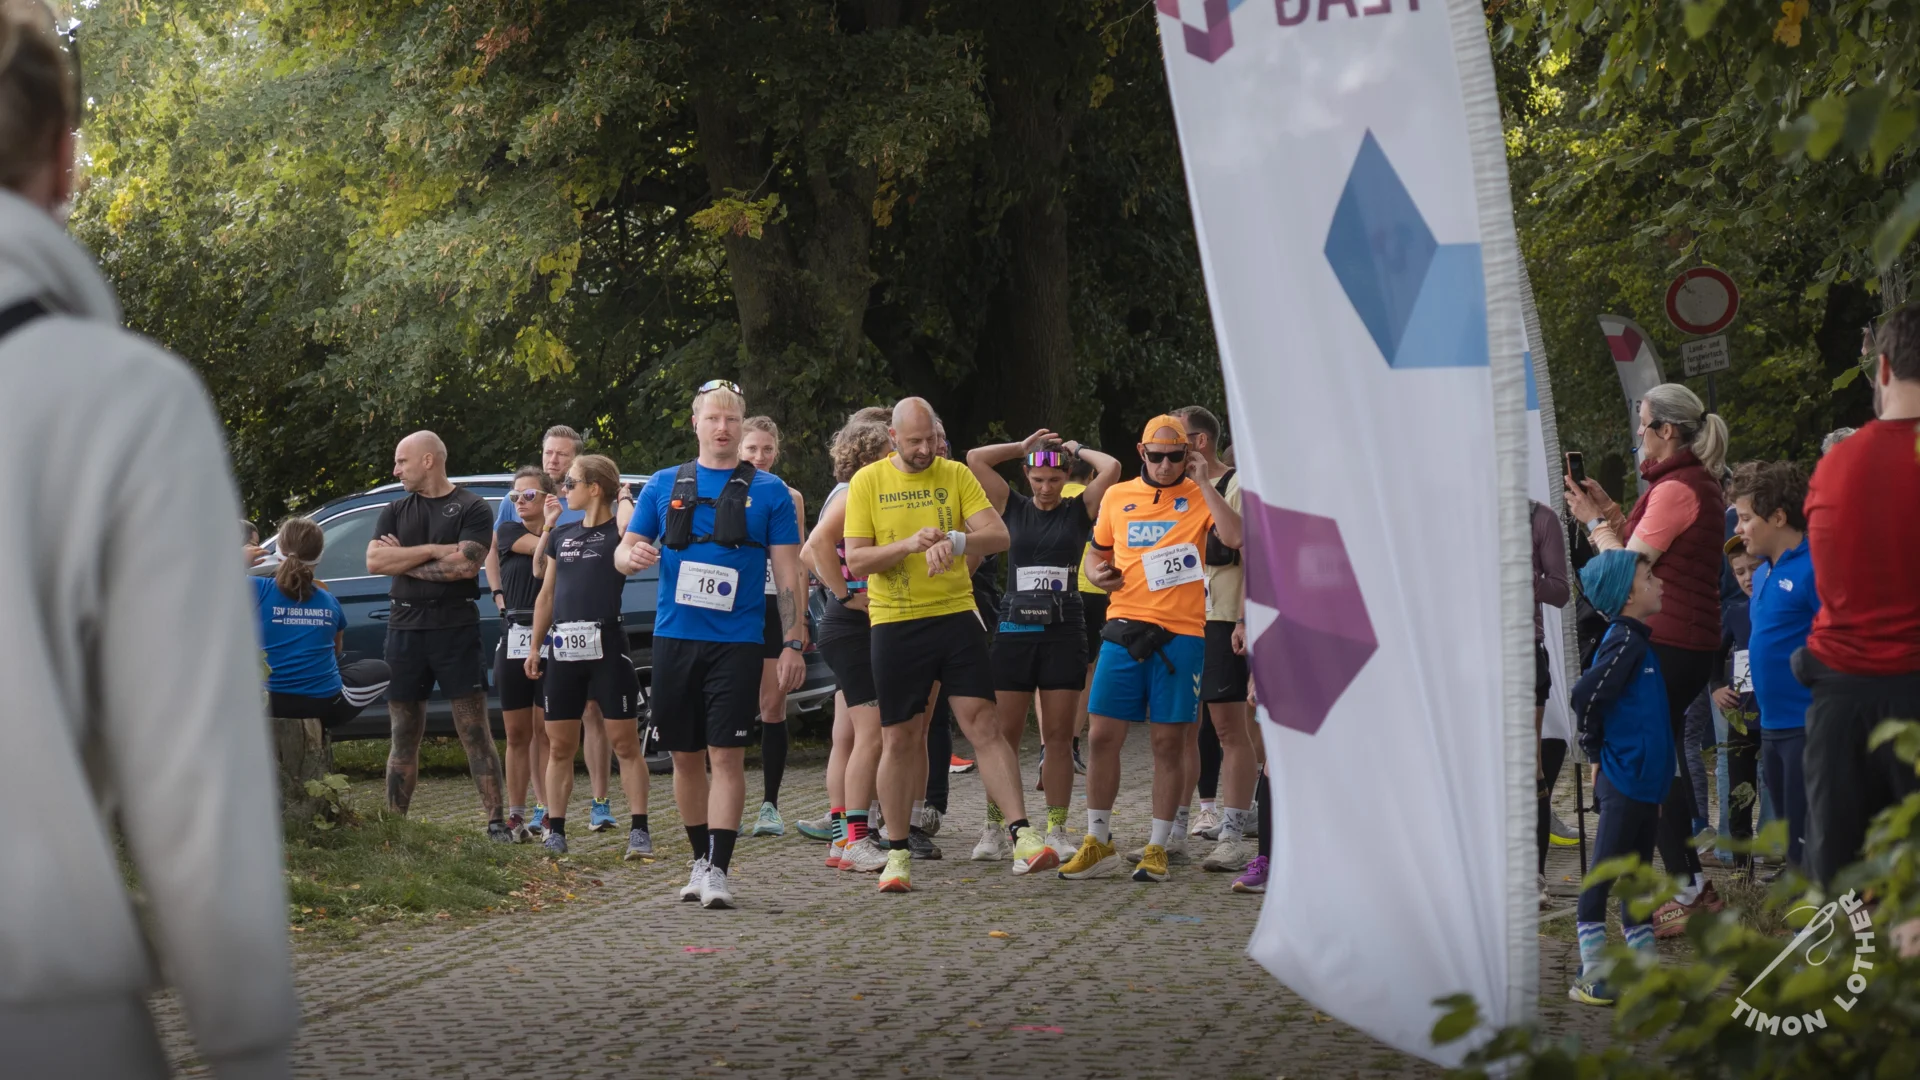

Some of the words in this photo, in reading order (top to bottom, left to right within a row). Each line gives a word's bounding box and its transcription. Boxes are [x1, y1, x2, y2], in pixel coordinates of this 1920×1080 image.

[879, 489, 931, 503] FINISHER
[906, 501, 920, 509] 21,2
[1129, 526, 1165, 543] SAP
[1150, 549, 1176, 560] Limberglauf
[689, 566, 715, 575] Limberglauf
[716, 569, 729, 577] Ranis
[1163, 557, 1182, 574] 25
[698, 577, 715, 594] 18
[1034, 577, 1049, 590] 20
[272, 606, 286, 615] TSV
[287, 607, 303, 616] 1860
[304, 608, 324, 617] RANIS
[283, 617, 324, 626] LEICHTATHLETIK
[564, 634, 586, 648] 198
[651, 726, 659, 741] 4
[1660, 908, 1684, 923] HOKA
